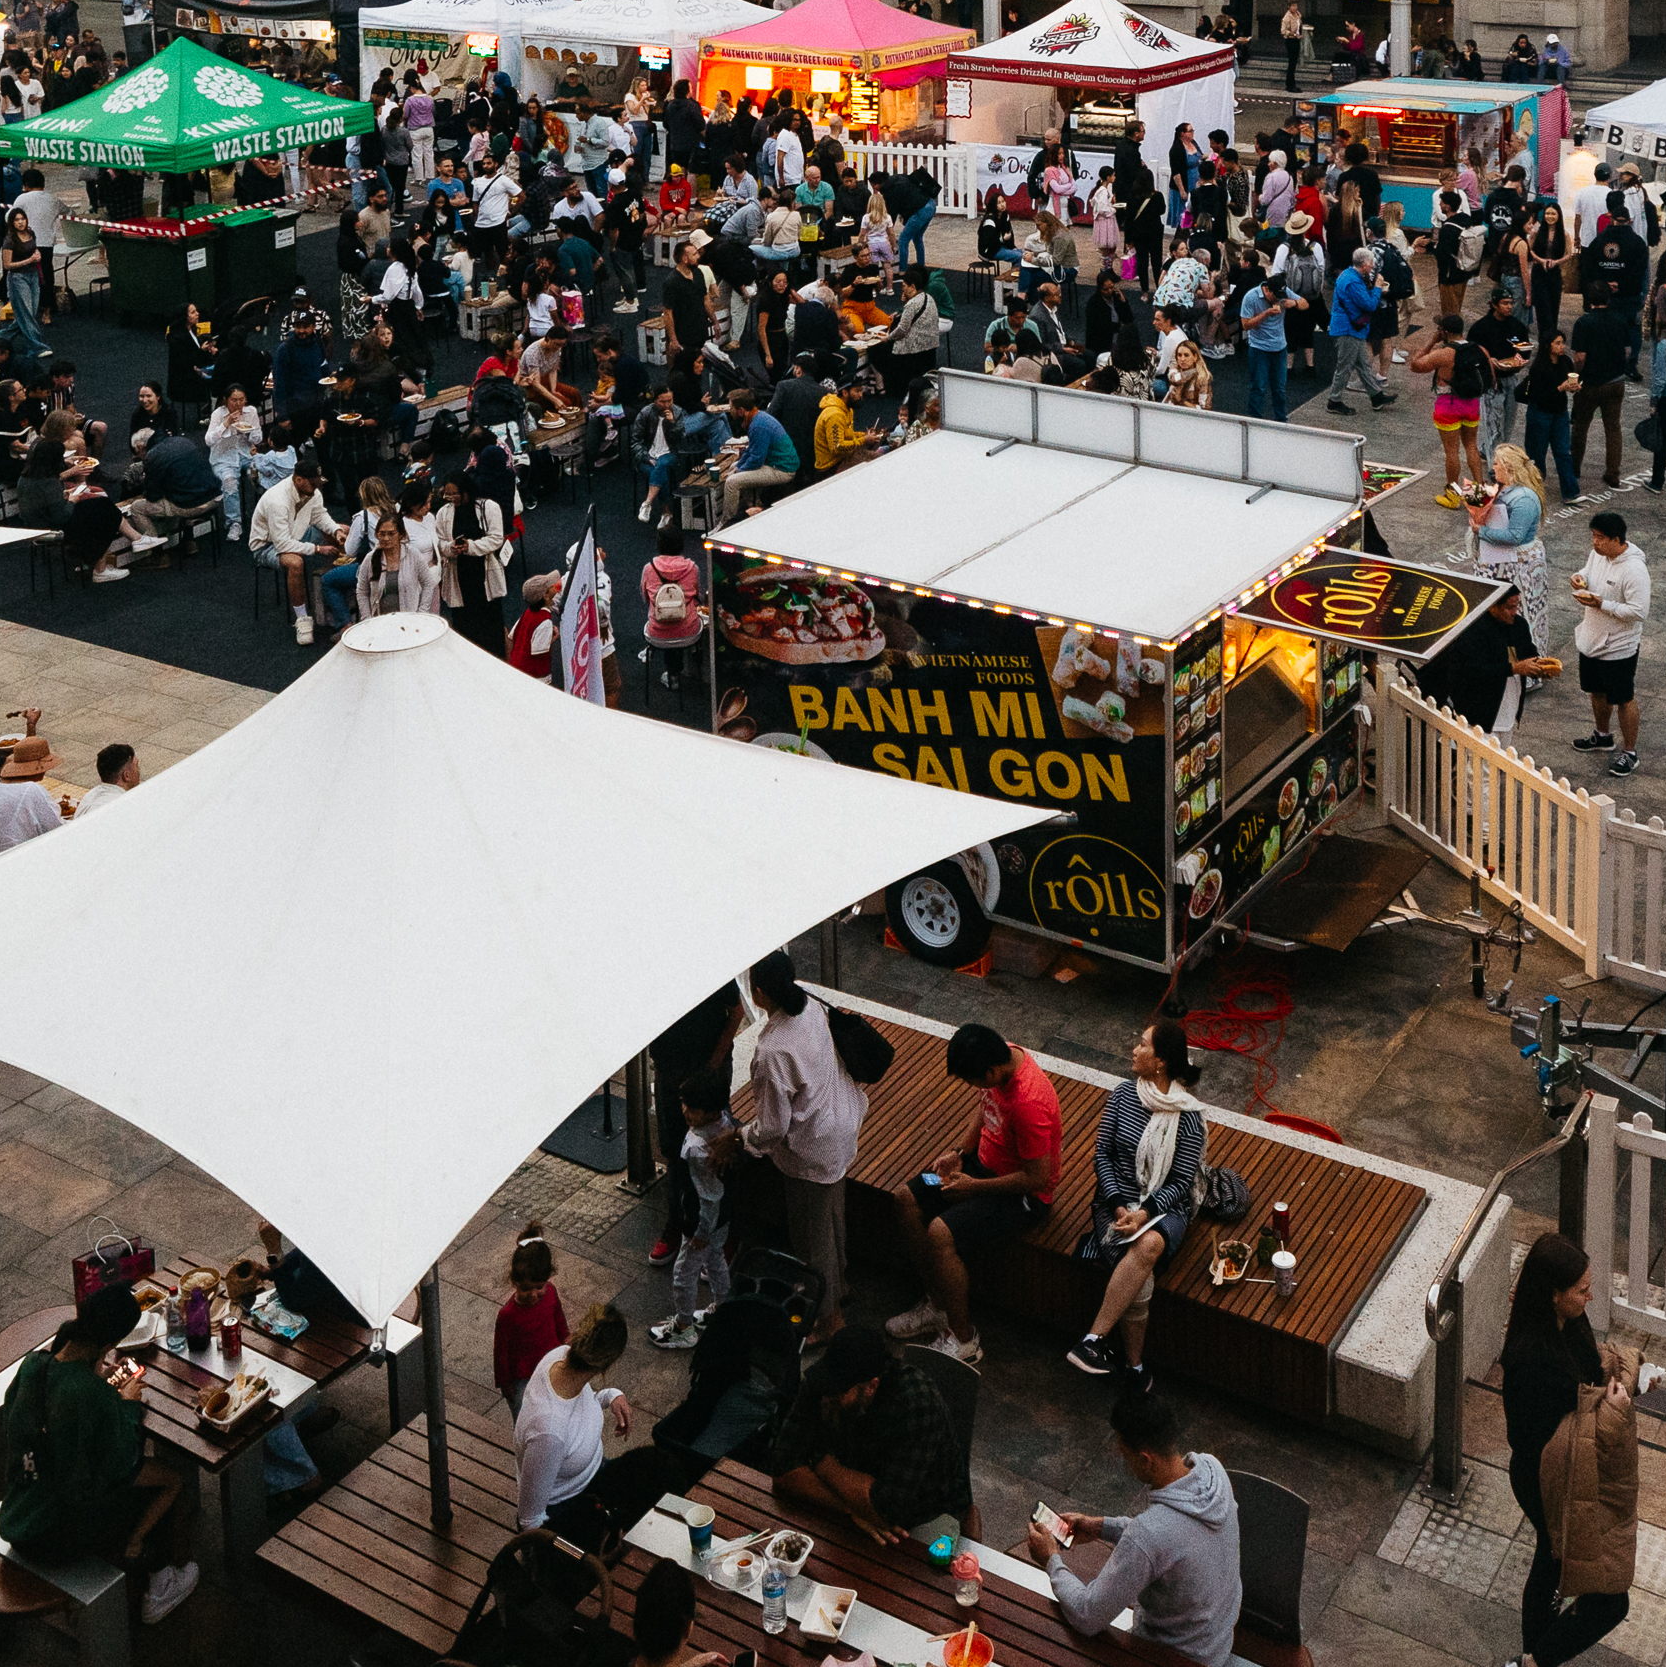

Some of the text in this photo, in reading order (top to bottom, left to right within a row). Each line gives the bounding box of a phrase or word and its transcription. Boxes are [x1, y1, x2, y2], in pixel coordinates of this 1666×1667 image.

[721, 47, 843, 66] AUTHENTIC INDIAN STREET FOOD
[884, 40, 964, 65] AUTHENTIC INDIAN STREET FOOD
[949, 61, 1137, 85] Fresh Strawberries Drizzled In Belgium Chocolate
[1139, 76, 1150, 85] Fresh
[1151, 70, 1177, 83] Strawberries
[1200, 59, 1215, 72] Belgium
[213, 116, 345, 161] WASTE STATION
[24, 136, 146, 167] WASTE STATION
[1402, 585, 1433, 628] VIETNAMESE
[1427, 587, 1448, 611] FOODS
[919, 653, 1032, 669] VIETNAMESE
[977, 671, 1035, 686] FOODS
[789, 685, 1046, 739] BANH MI
[988, 748, 1131, 802] GON
